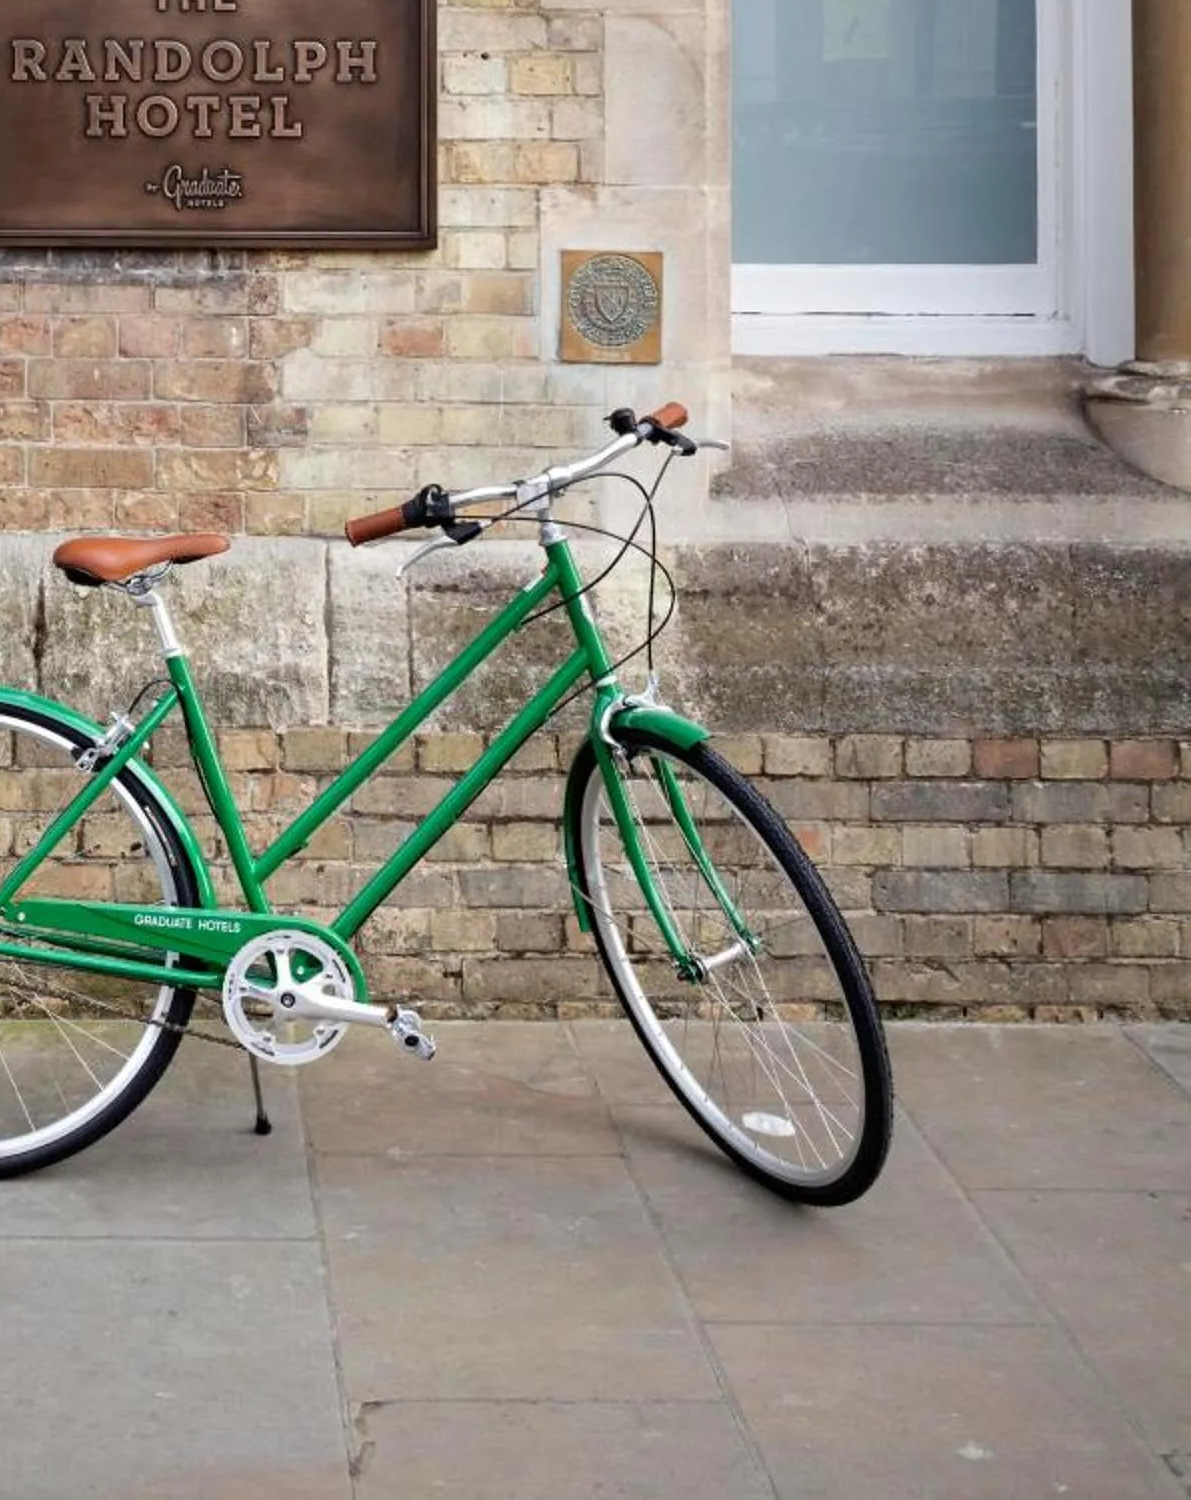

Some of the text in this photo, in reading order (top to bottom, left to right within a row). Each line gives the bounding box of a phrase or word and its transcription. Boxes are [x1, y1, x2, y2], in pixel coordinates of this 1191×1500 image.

[10, 37, 378, 83] RANDOLPH
[84, 94, 303, 138] HOTEL
[134, 914, 241, 933] GRADUATE HOTELS
